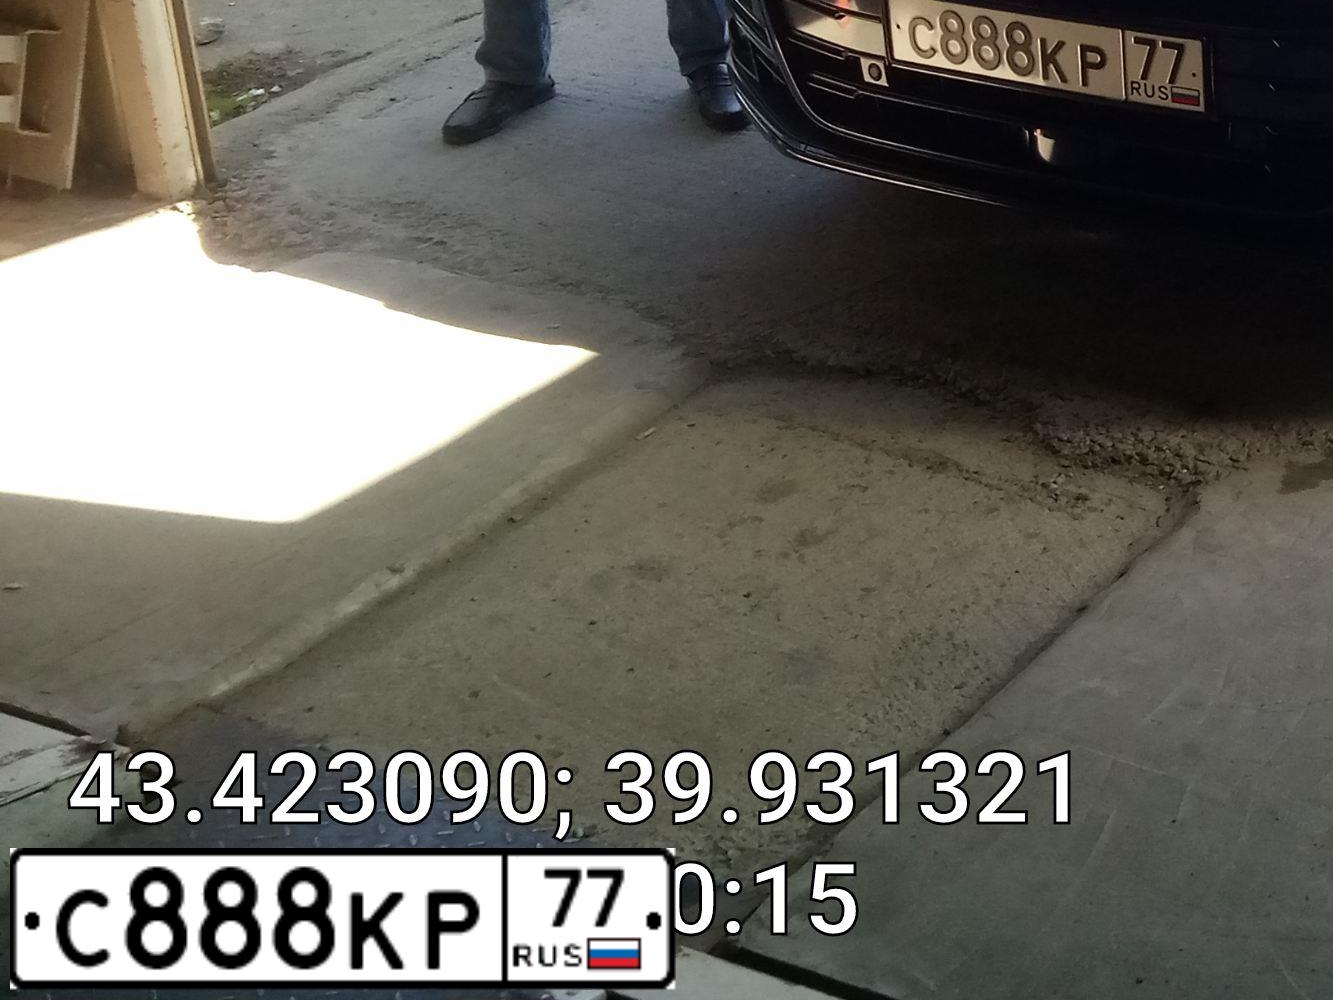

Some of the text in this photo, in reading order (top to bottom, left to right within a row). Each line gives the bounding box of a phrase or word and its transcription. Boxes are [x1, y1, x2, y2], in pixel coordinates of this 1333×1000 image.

[907, 9, 1185, 88] С888КР 77
[1130, 81, 1170, 101] RUS
